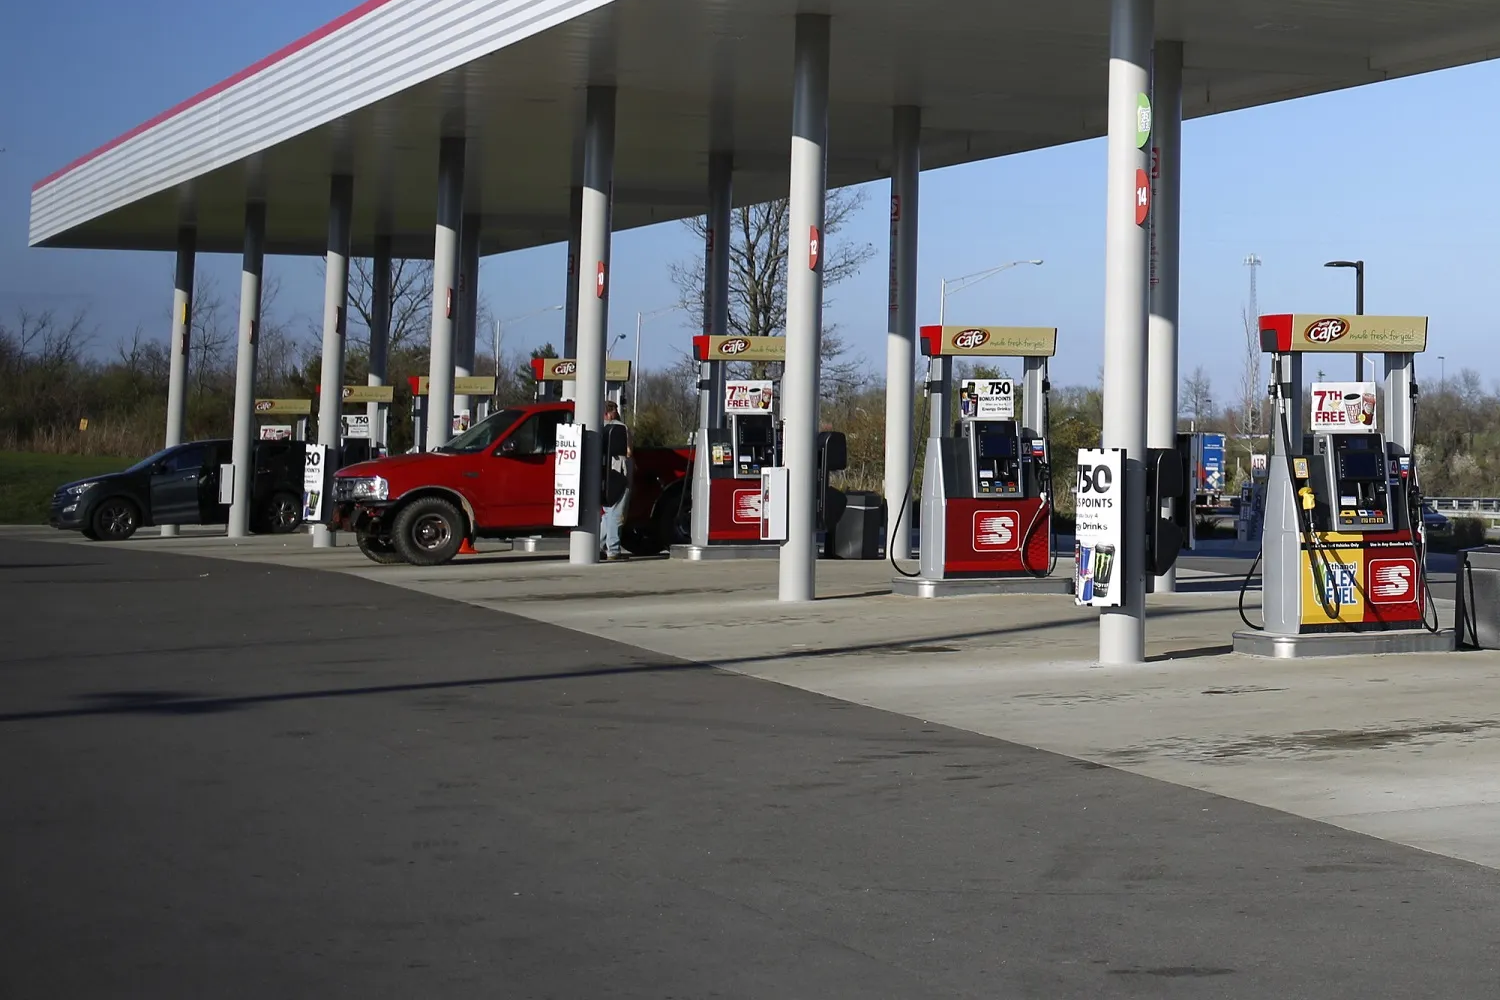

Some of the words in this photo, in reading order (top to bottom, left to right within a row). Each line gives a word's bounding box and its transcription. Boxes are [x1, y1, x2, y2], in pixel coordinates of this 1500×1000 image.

[1137, 187, 1148, 207] 14
[1370, 328, 1389, 340] fresh
[1389, 329, 1399, 340] for
[988, 382, 1011, 395] 750
[355, 416, 369, 424] 750
[1315, 411, 1346, 422] FREE
[1252, 458, 1265, 470] AIR
[1082, 498, 1113, 508] POINTS
[1082, 522, 1108, 530] Drinks
